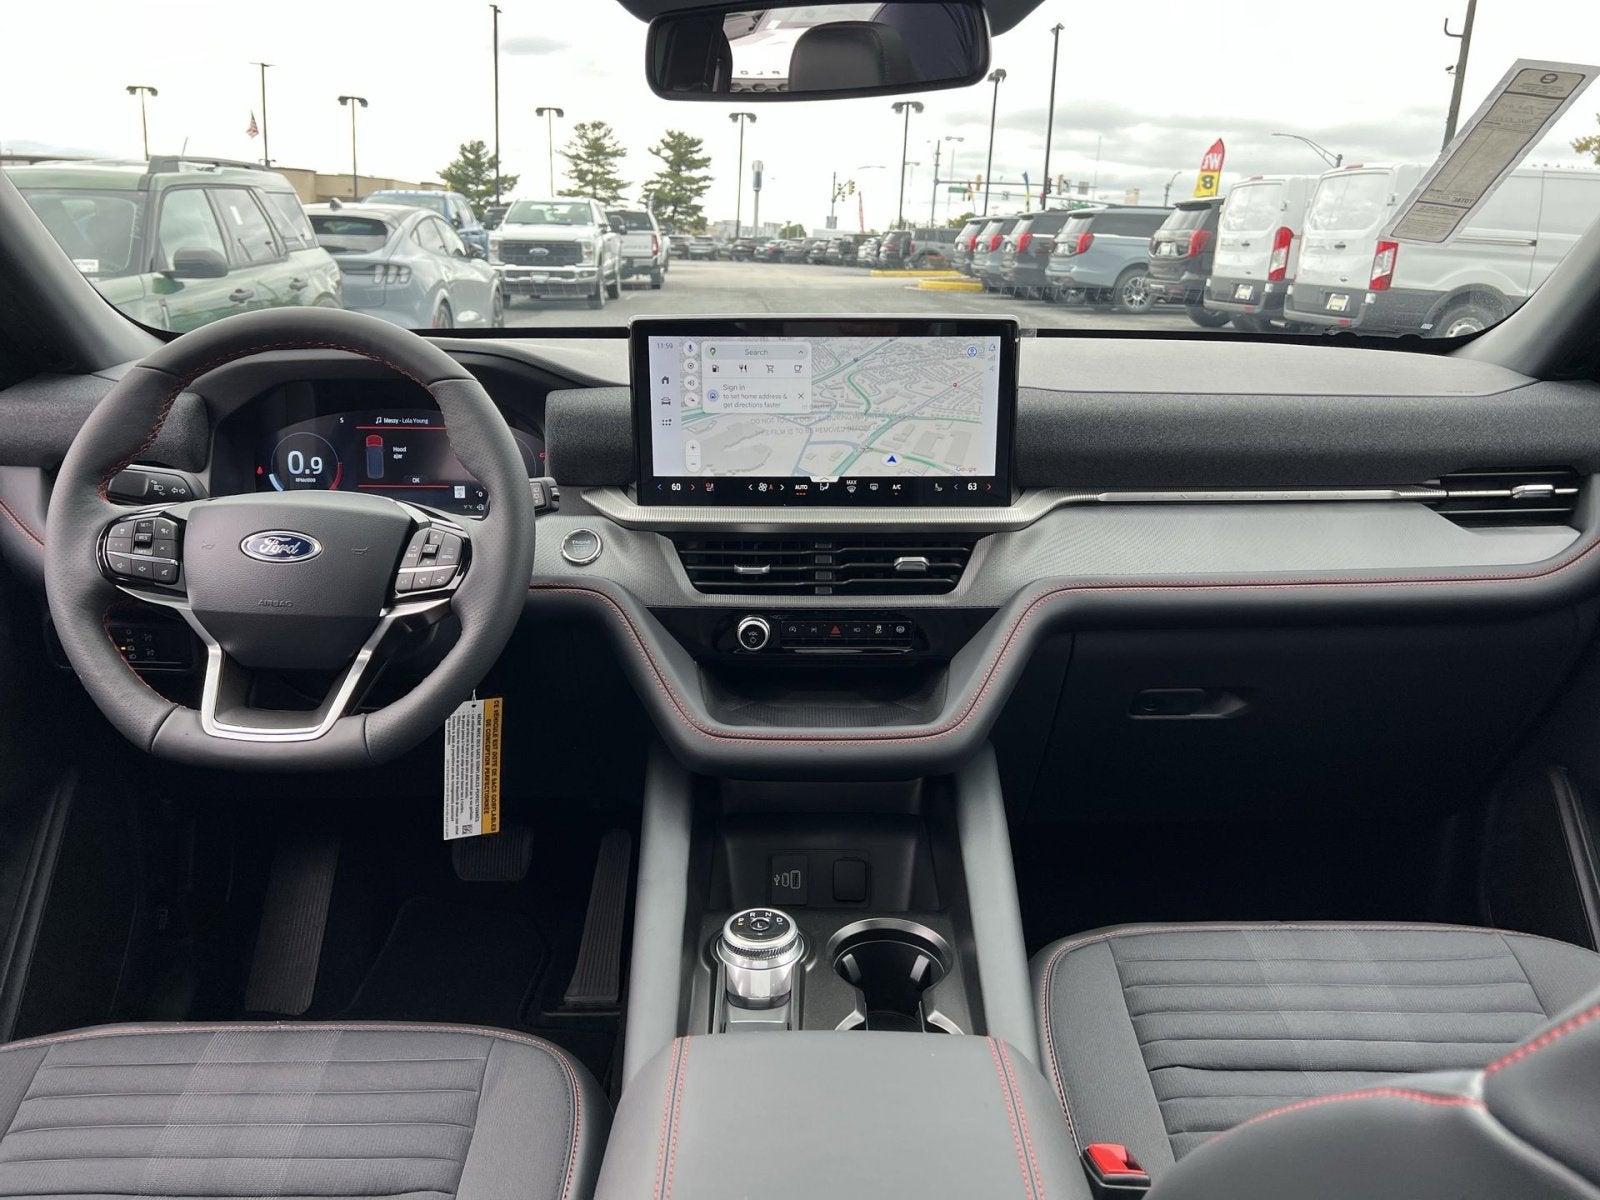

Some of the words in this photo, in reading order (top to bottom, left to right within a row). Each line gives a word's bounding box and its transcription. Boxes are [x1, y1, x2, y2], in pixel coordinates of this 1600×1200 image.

[1202, 174, 1214, 190] 8
[288, 450, 323, 474] 0.9
[967, 483, 977, 491] 63
[494, 700, 500, 709] CE
[486, 719, 491, 728] DE
[492, 768, 497, 776] DE
